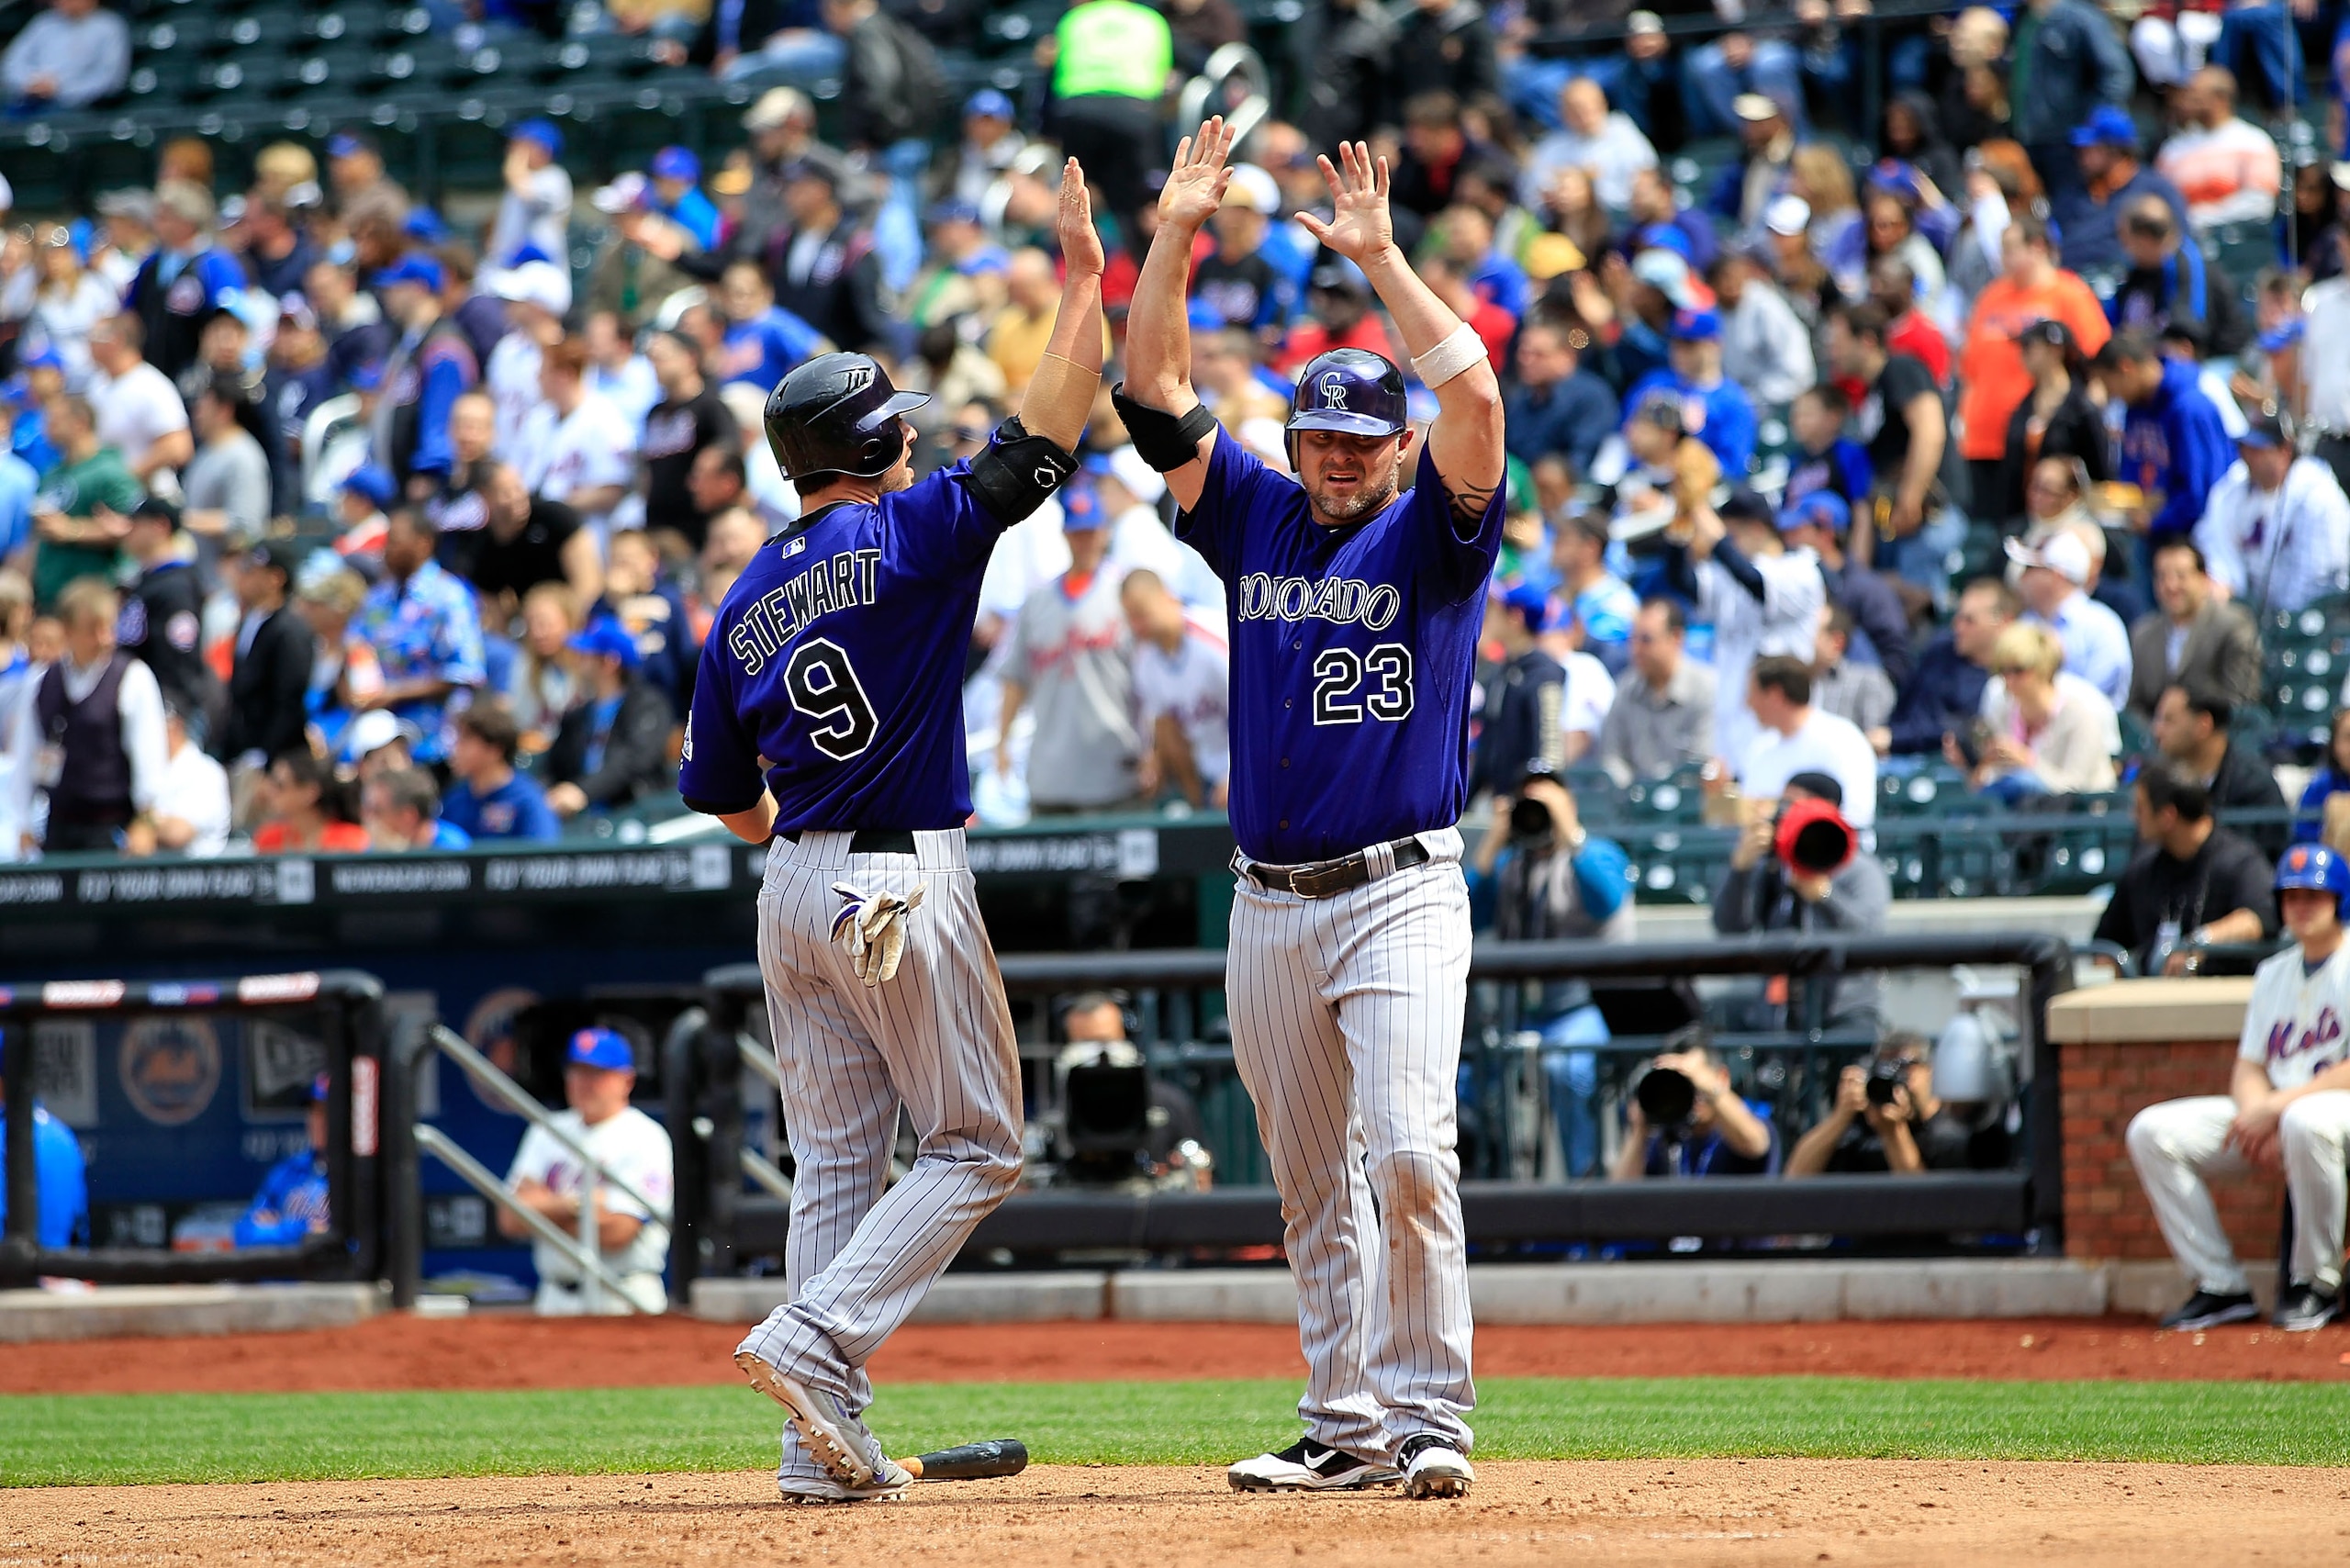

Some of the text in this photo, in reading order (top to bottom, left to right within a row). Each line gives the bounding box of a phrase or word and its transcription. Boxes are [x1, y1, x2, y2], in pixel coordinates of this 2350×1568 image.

[729, 549, 881, 676] STEWART
[783, 636, 879, 761] 9
[1313, 643, 1415, 726] 23
